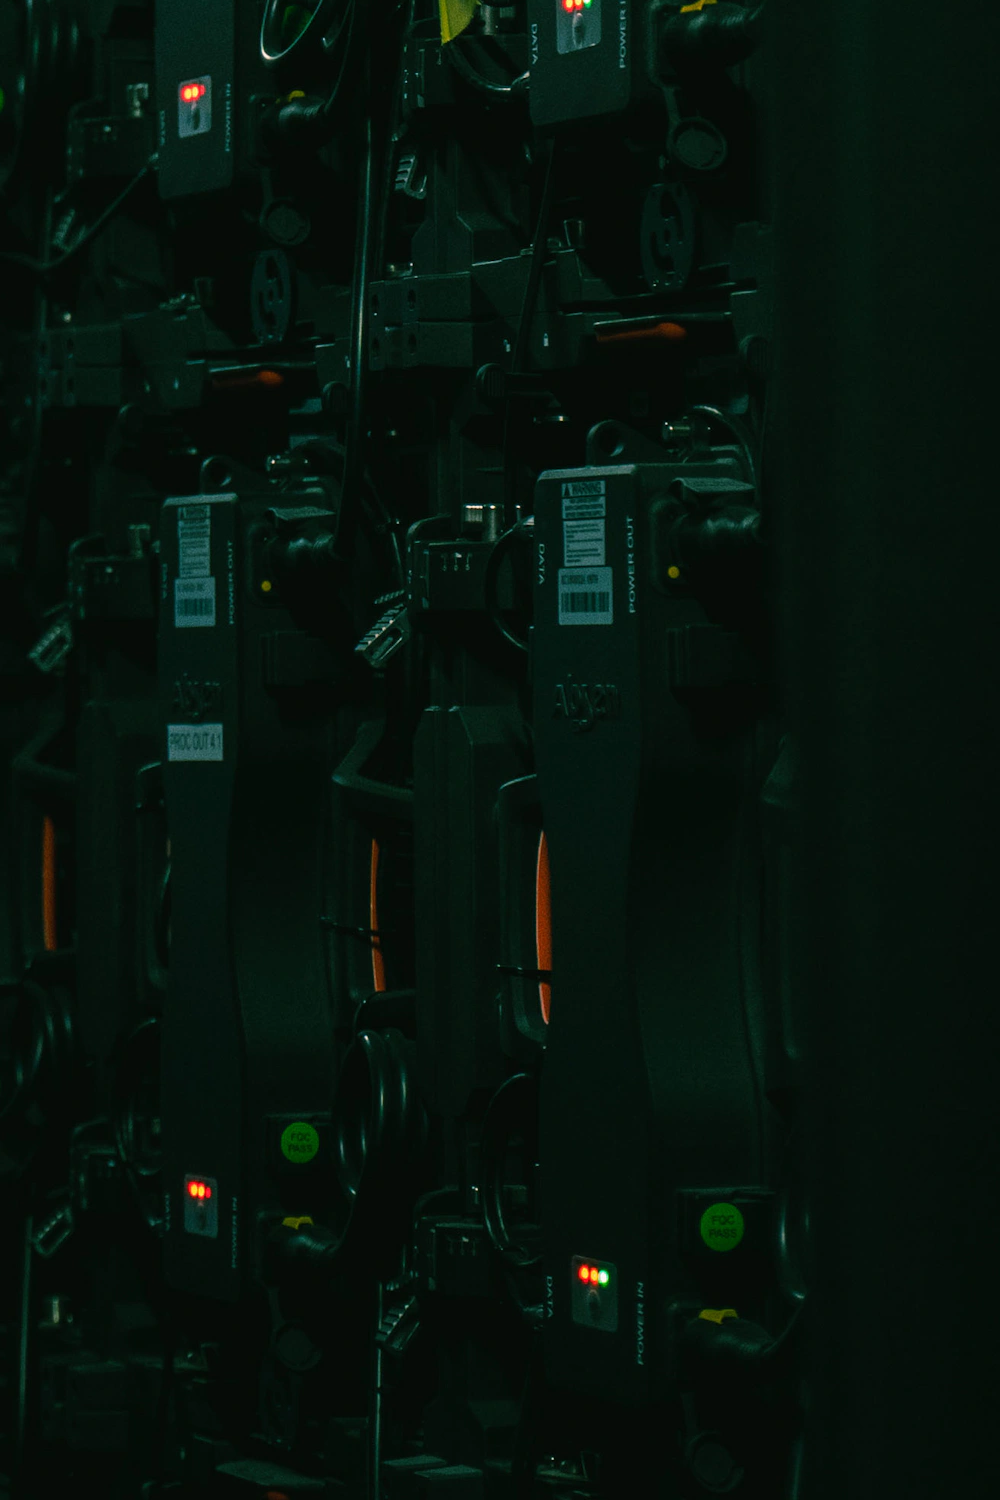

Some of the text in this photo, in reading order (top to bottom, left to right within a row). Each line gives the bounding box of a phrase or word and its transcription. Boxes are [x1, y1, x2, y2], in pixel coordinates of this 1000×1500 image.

[531, 23, 539, 65] DATA
[618, 9, 627, 69] POWER
[226, 539, 235, 625] POWER OUT
[538, 543, 546, 585] DATA
[625, 515, 637, 614] POWER OUT
[192, 732, 208, 751] OUT
[287, 1143, 314, 1153] PASS
[708, 1227, 738, 1239] PASS
[546, 1275, 554, 1318] DATA
[636, 1281, 645, 1366] POWER IN
